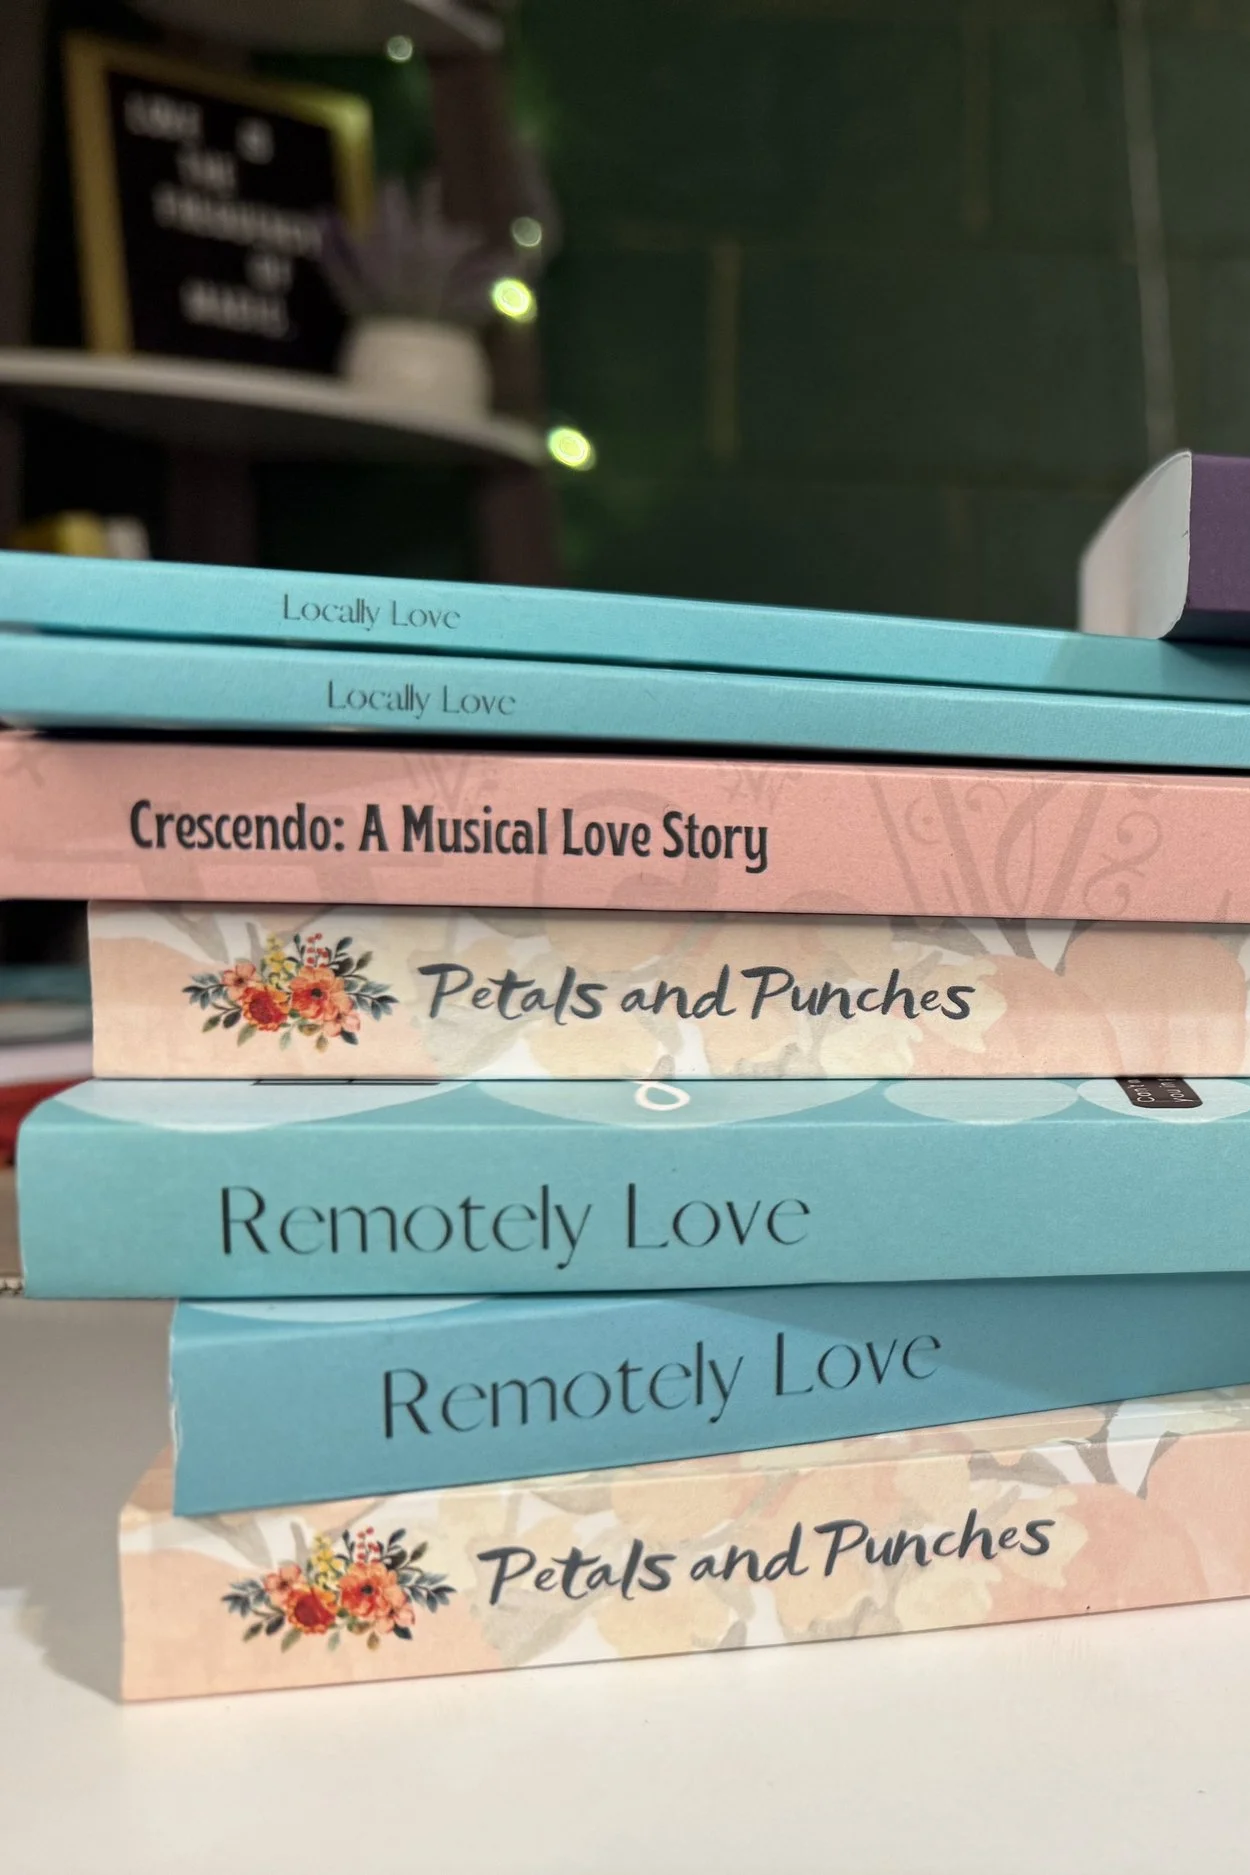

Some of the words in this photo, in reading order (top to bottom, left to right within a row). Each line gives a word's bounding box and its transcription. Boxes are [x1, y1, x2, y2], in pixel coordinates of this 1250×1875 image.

[283, 593, 380, 631] Locally
[391, 600, 461, 629] Love
[328, 680, 431, 719] Locally
[442, 685, 516, 715] Love
[129, 799, 345, 852] Crescendo:
[358, 804, 389, 852] A
[402, 804, 548, 855] Musical
[562, 808, 651, 857] Love
[663, 811, 768, 874] Story
[417, 963, 601, 1027] Petals
[620, 964, 735, 1019] and
[740, 964, 976, 1020] Punches
[221, 1184, 593, 1270] Remotely
[626, 1182, 811, 1250] Love
[383, 1341, 745, 1439] Remotely
[775, 1332, 942, 1398] Love
[477, 1538, 678, 1606] Petals
[689, 1522, 807, 1583] and
[813, 1508, 1056, 1577] Punches
